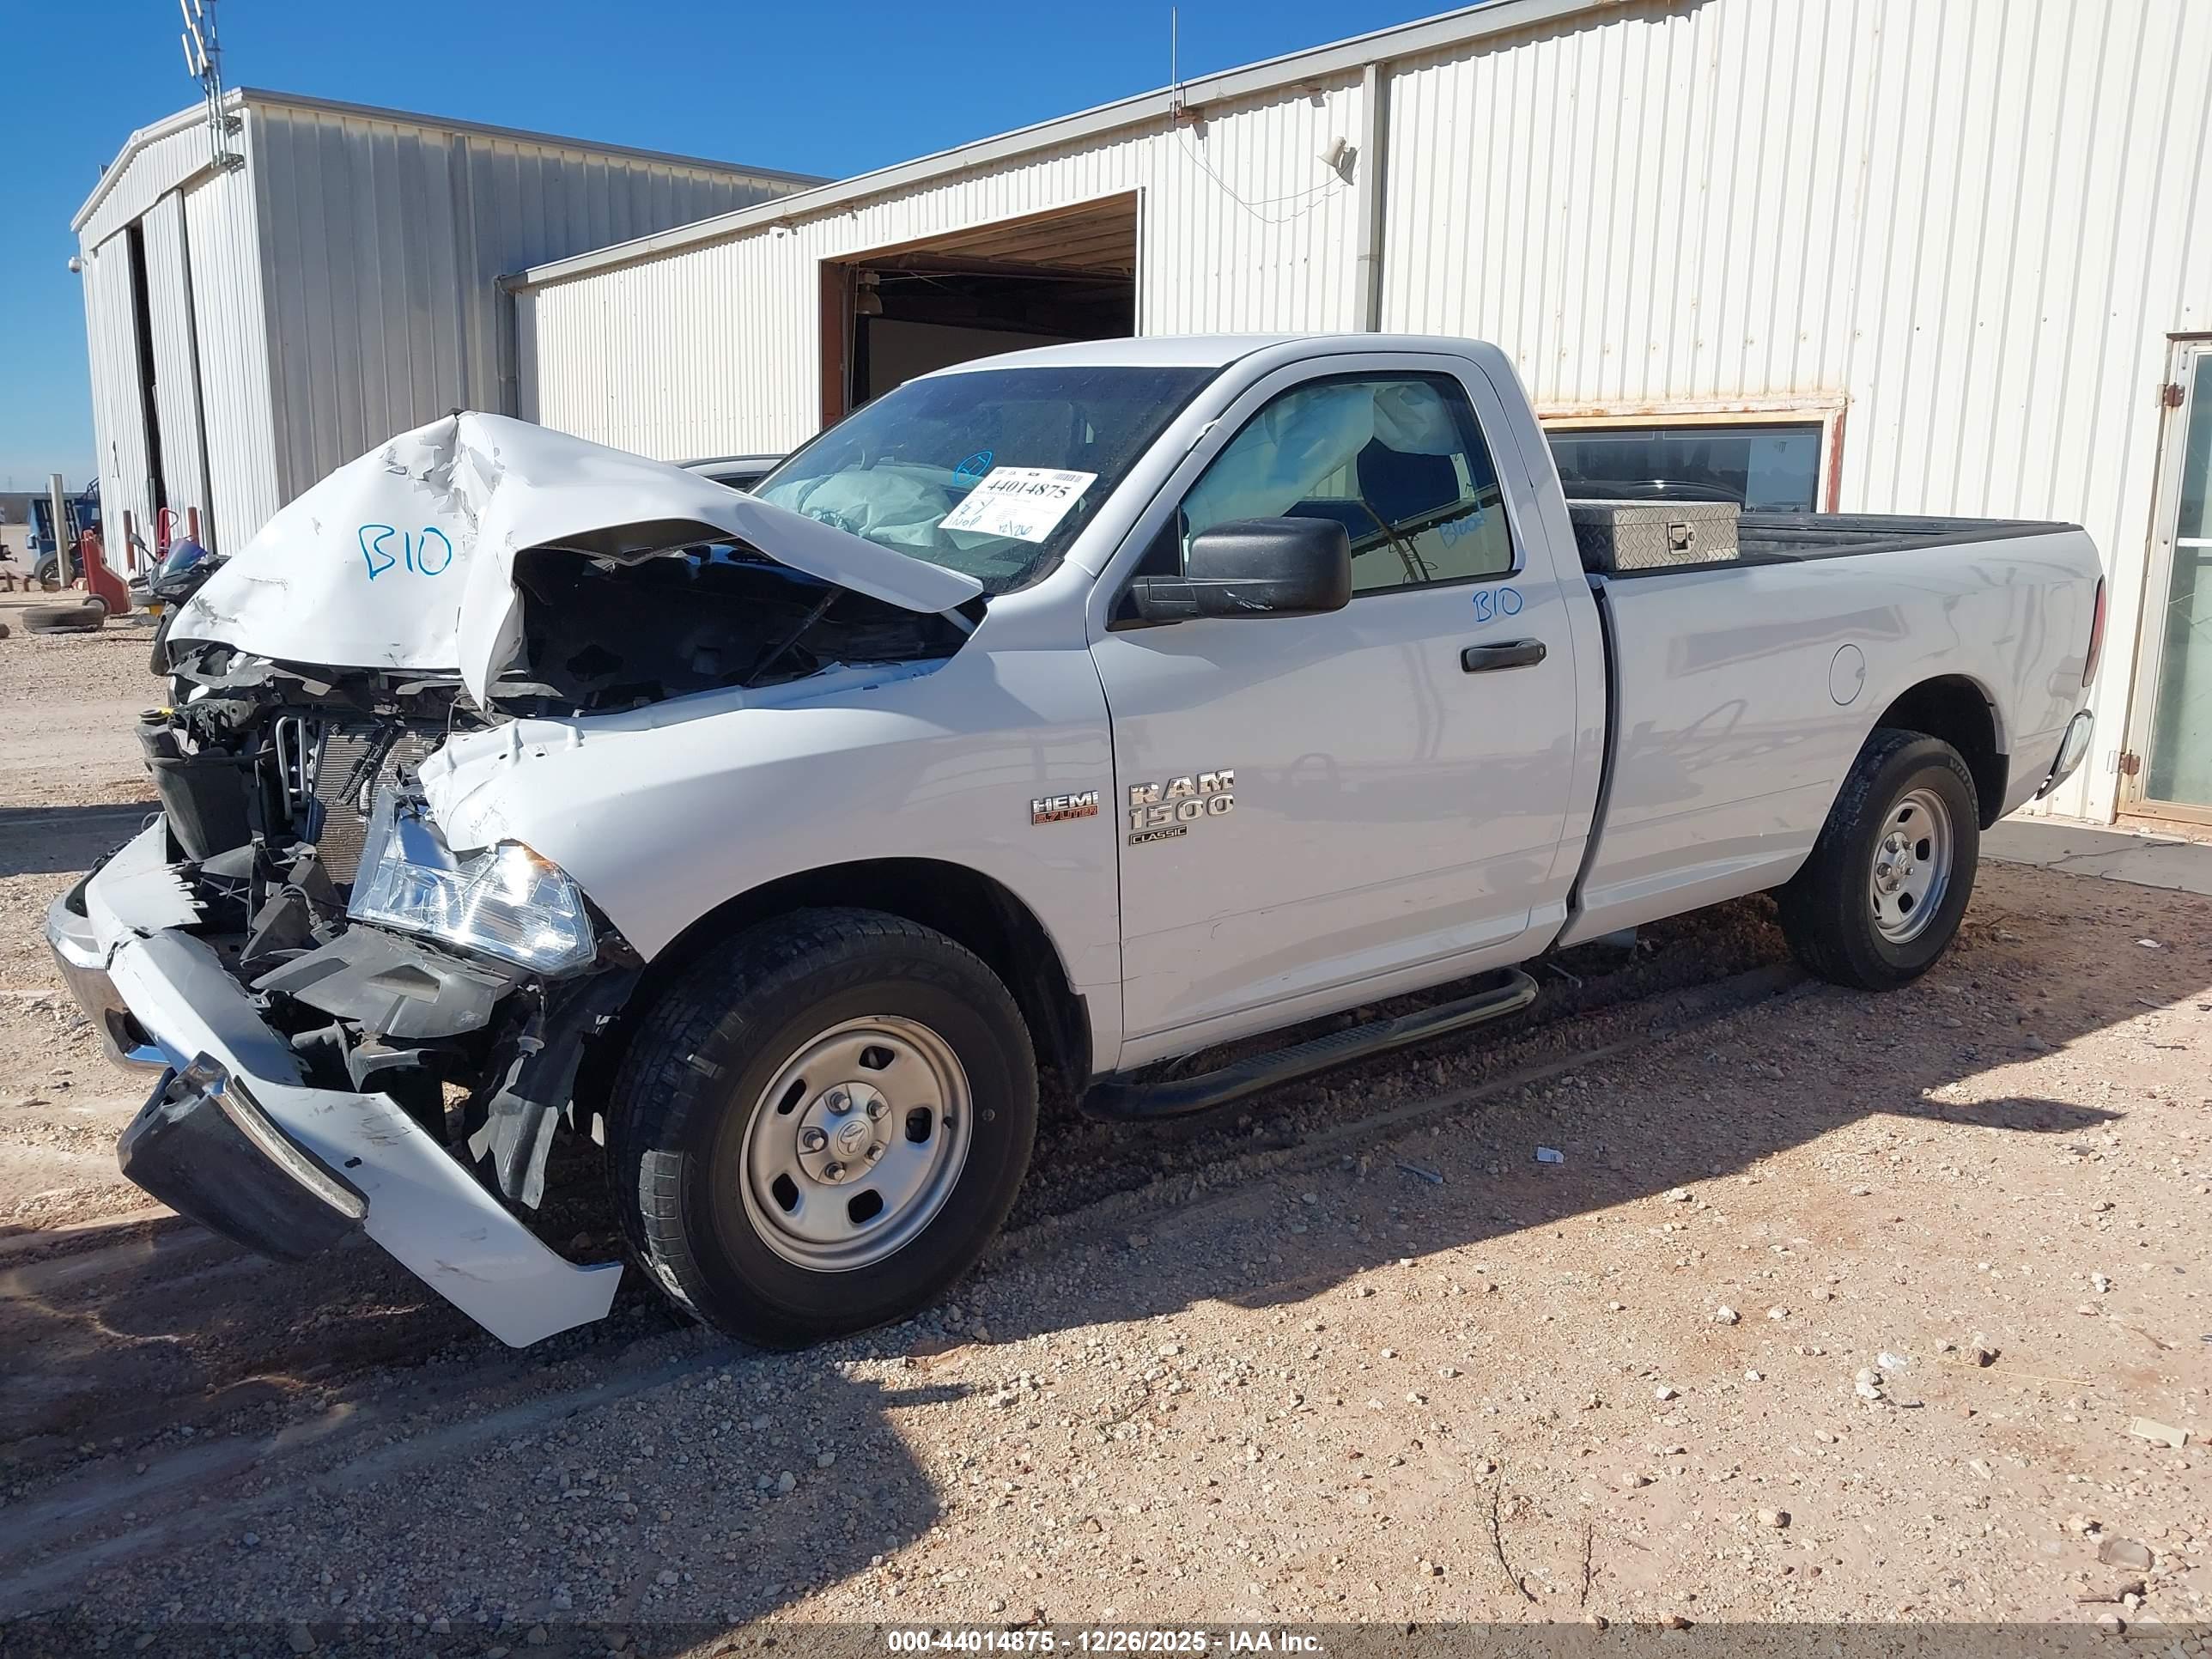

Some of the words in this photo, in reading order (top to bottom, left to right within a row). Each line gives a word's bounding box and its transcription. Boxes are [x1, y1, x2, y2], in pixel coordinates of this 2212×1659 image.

[987, 479, 1072, 499] 44014875
[1129, 769, 1235, 805] RAM
[1032, 790, 1099, 813] HEMI
[1129, 793, 1235, 830] 1500
[1132, 827, 1187, 844] CLASSIC
